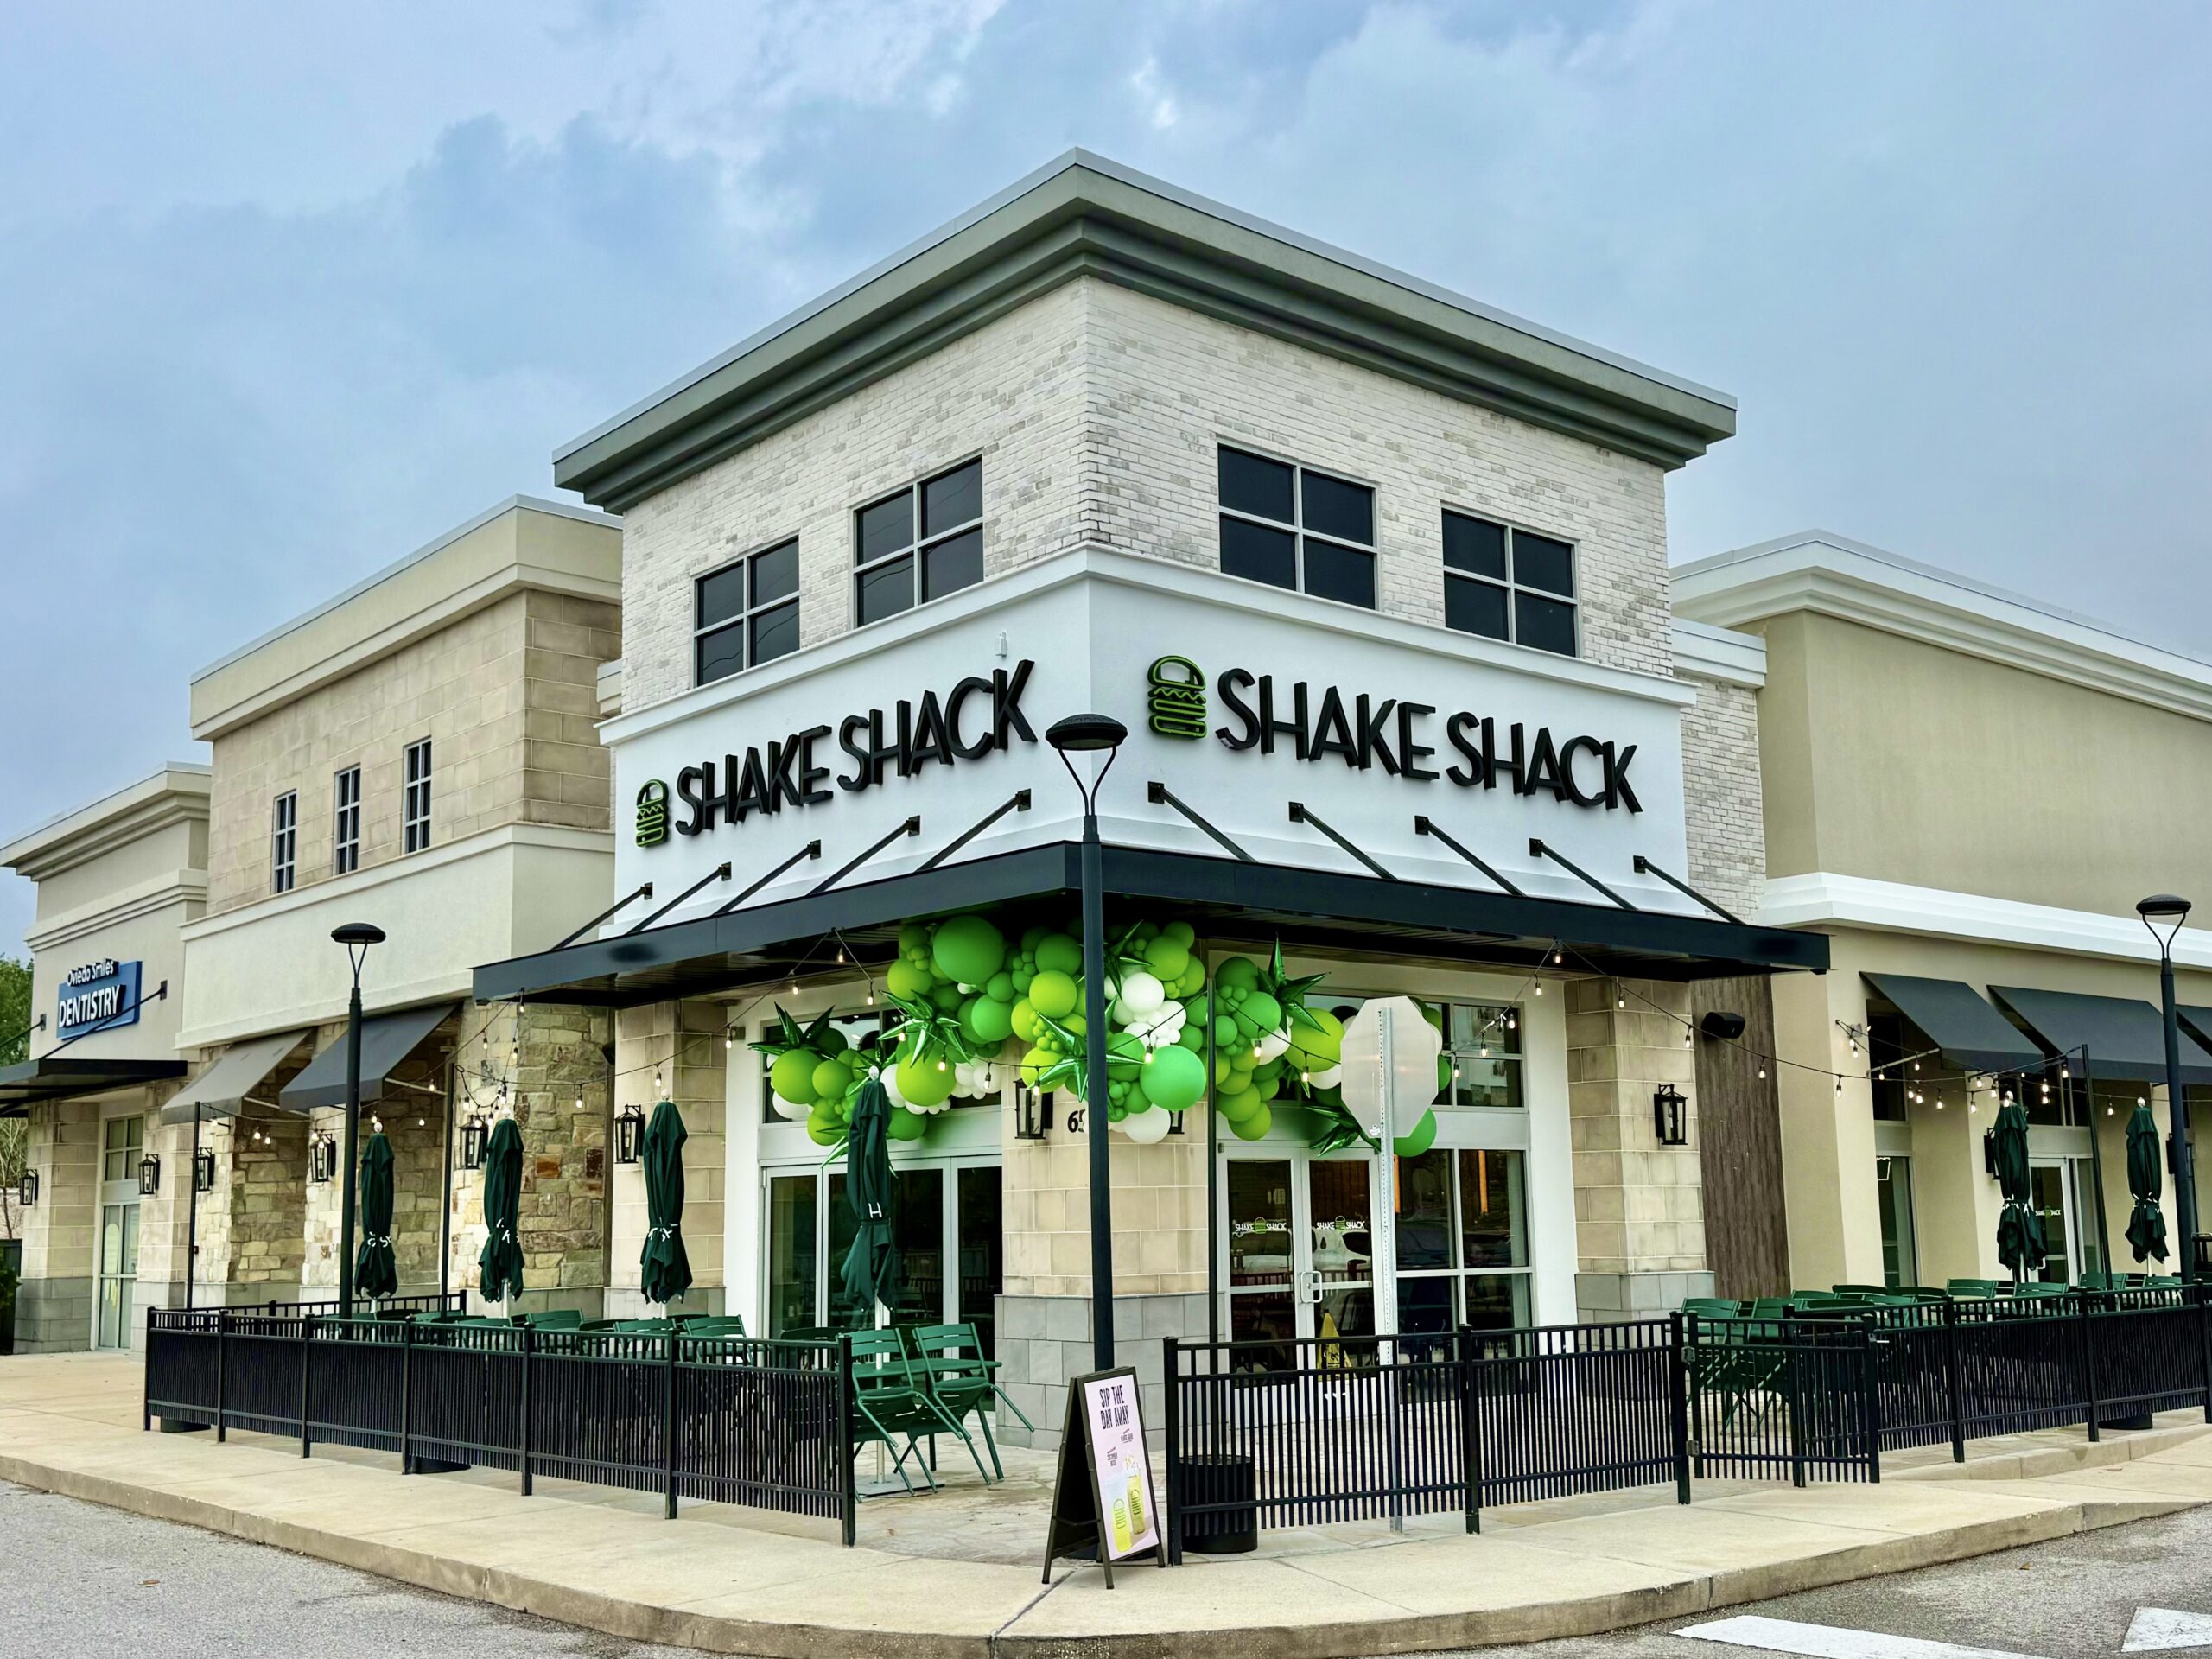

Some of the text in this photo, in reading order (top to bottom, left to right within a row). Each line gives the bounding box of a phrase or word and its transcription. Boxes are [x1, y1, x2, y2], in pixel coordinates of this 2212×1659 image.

[675, 659, 1038, 836] SHAKE SHACK
[1215, 667, 1643, 814] SHAKE SHACK
[67, 958, 115, 987] Oviedo Smiles
[59, 984, 122, 1028] DENTISTRY
[1235, 1222, 1287, 1232] SHAKE SHACK
[1316, 1220, 1365, 1230] SHAKE SHACK
[1099, 1384, 1125, 1408] SIP THE
[1100, 1405, 1130, 1430] DAY AWAY
